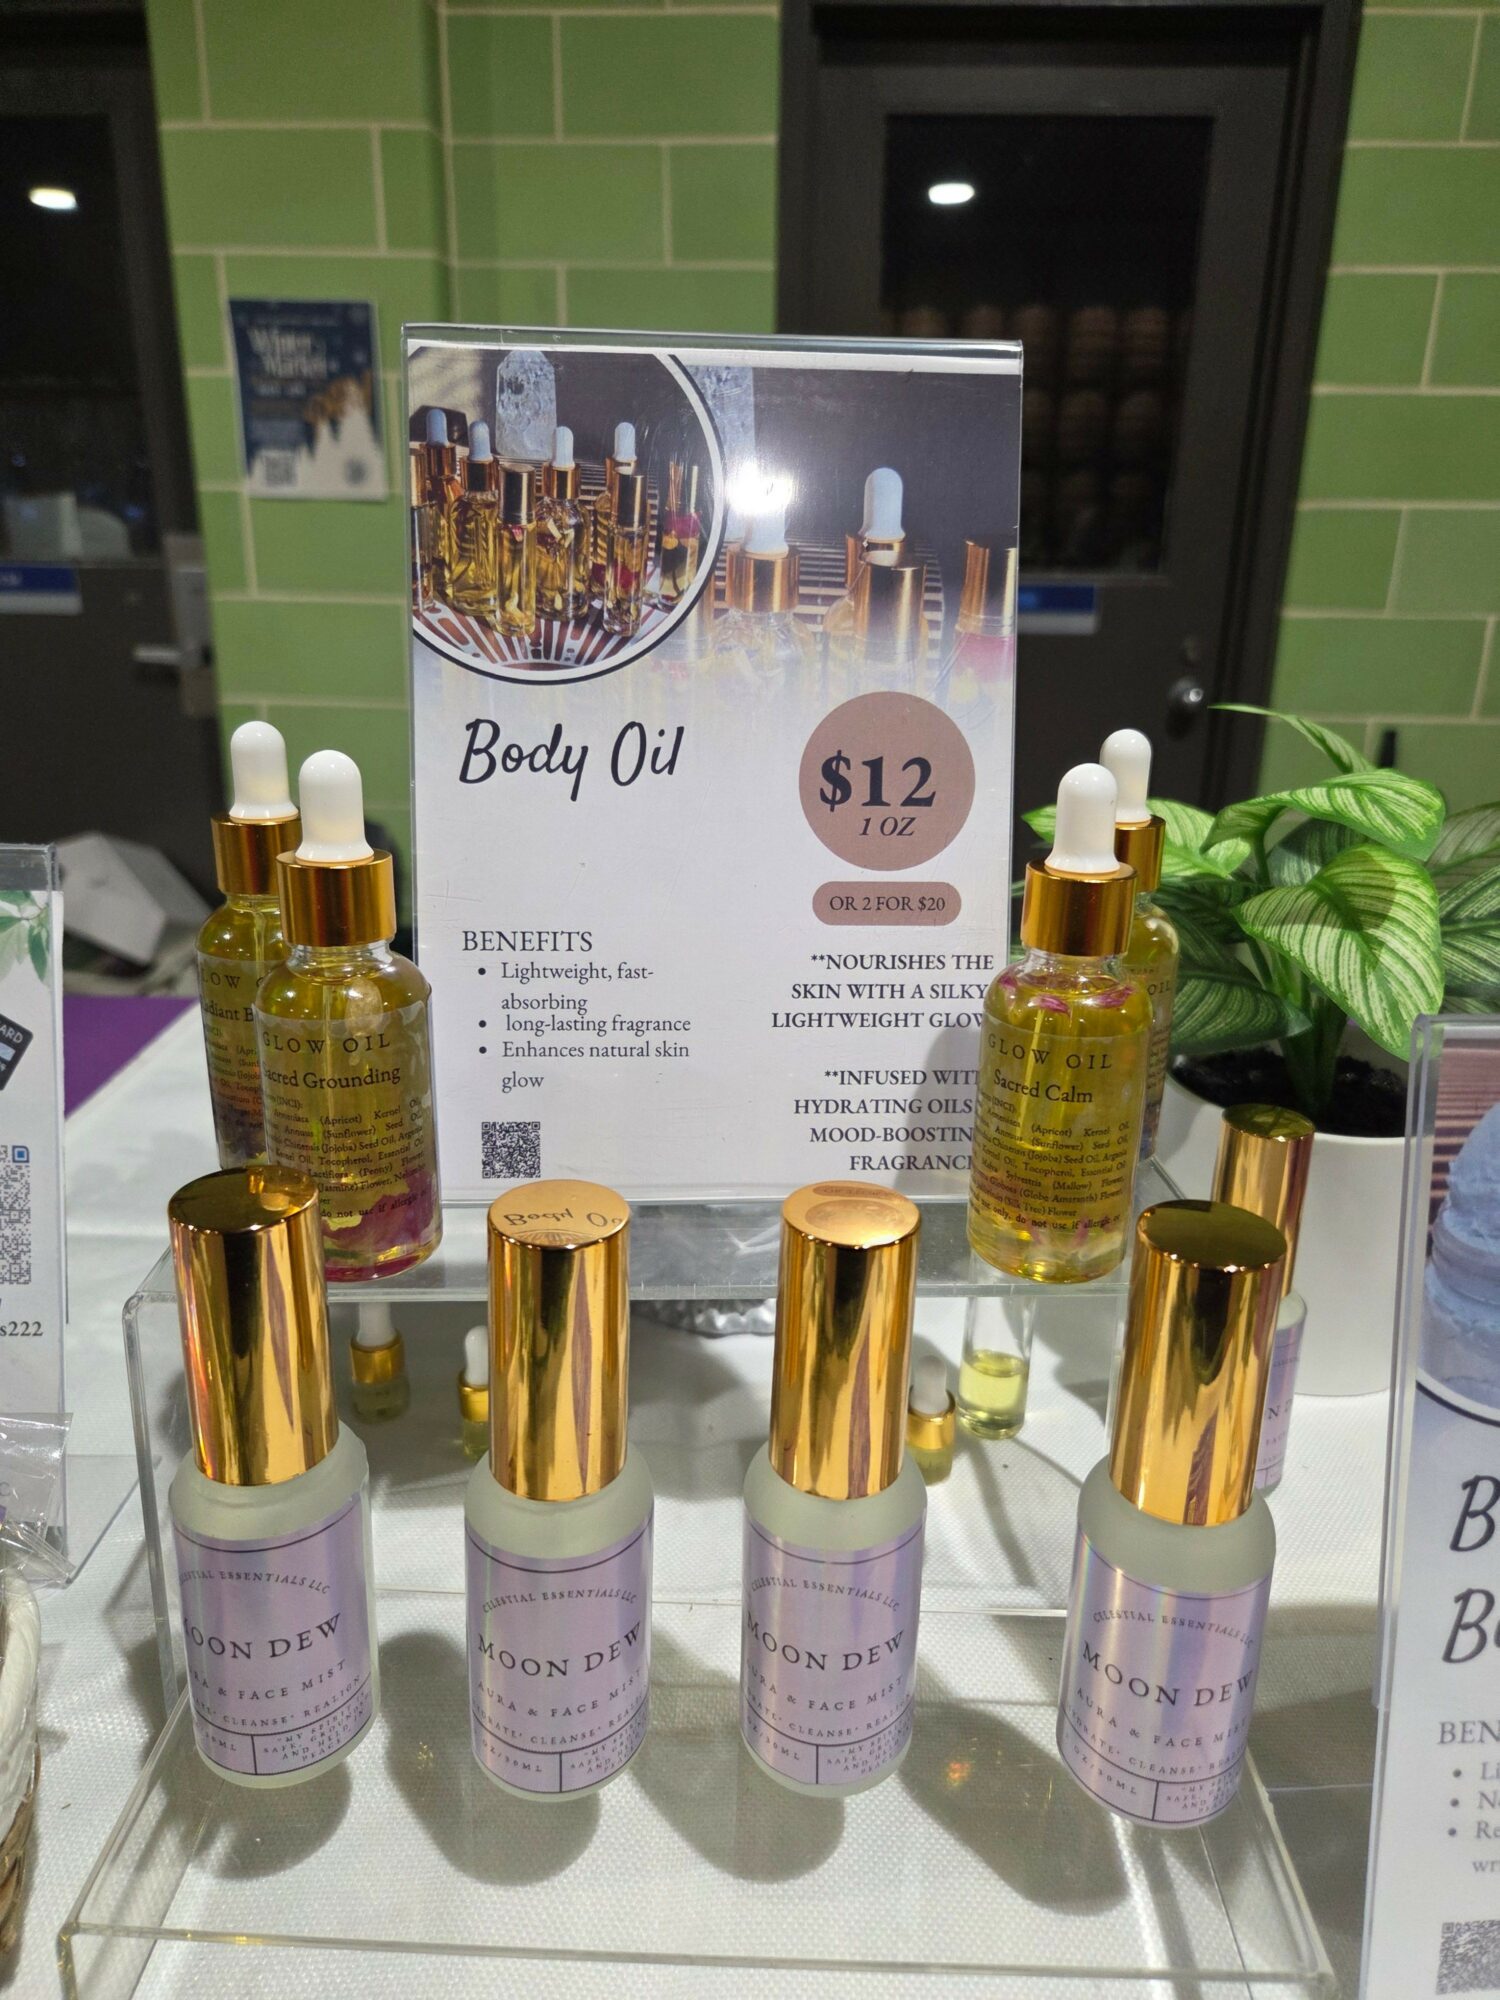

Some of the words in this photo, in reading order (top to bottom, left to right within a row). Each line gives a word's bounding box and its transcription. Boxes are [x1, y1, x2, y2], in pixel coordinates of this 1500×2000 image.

[459, 718, 589, 802] Body
[610, 720, 685, 787] Oil
[819, 749, 937, 812] $12
[859, 818, 871, 836] 1
[879, 816, 917, 837] OZ
[829, 896, 858, 911] OR
[862, 896, 871, 911] 2
[875, 896, 914, 911] FOR
[918, 896, 946, 913] $20
[461, 930, 593, 951] BENEFITS
[501, 962, 612, 985] Lightweight,
[616, 961, 654, 979] fast-
[951, 955, 995, 970] THE
[791, 983, 842, 1000] SKIN
[846, 984, 906, 999] WITH
[911, 984, 925, 1000] A
[930, 984, 989, 1000] SILKY
[501, 993, 588, 1016] absorbing
[505, 1015, 607, 1036] long-lasting
[611, 1015, 691, 1036] fragrance
[771, 1011, 925, 1028] LIGHTWEIGHT
[0, 1024, 23, 1044] ARD
[263, 1031, 325, 1055] GLOW
[343, 1033, 391, 1053] OIL
[502, 1041, 585, 1058] Enhances
[588, 1041, 651, 1058] natural
[654, 1041, 690, 1058] skin
[988, 1033, 1050, 1065] GLOW
[1065, 1053, 1112, 1070] OIL
[303, 1067, 401, 1089] Grounding
[501, 1071, 544, 1094] glow
[994, 1068, 1040, 1099] Sacred
[1046, 1084, 1093, 1104] Calm
[794, 1098, 922, 1115] HYDRATING
[927, 1098, 972, 1114] OILS
[810, 1126, 972, 1143] MOOD-BOOSTIN
[336, 1208, 353, 1218] not
[219, 1571, 305, 1586] ESSENTIALS
[309, 1579, 330, 1594] LLC
[803, 1579, 882, 1603] ESSENTIALS
[542, 1589, 623, 1601] ESSENTIALS
[268, 1611, 341, 1658] DEW
[747, 1610, 828, 1671] MOON
[841, 1628, 904, 1671] DEW
[478, 1631, 569, 1678] MOON
[584, 1619, 640, 1673] DEW
[217, 1686, 227, 1698] &
[237, 1687, 289, 1701] FACE
[302, 1658, 346, 1692] MIST
[1083, 1640, 1180, 1707] MOON
[1194, 1668, 1254, 1707] DEW
[479, 1680, 517, 1712] AURA
[528, 1707, 539, 1718] &
[550, 1698, 600, 1718] FACE
[786, 1694, 798, 1706] &
[808, 1699, 856, 1711] FACE
[867, 1674, 904, 1704] MIST
[1077, 1687, 1118, 1729] AURA
[1129, 1727, 1140, 1739] &
[1153, 1735, 1204, 1749] FACE
